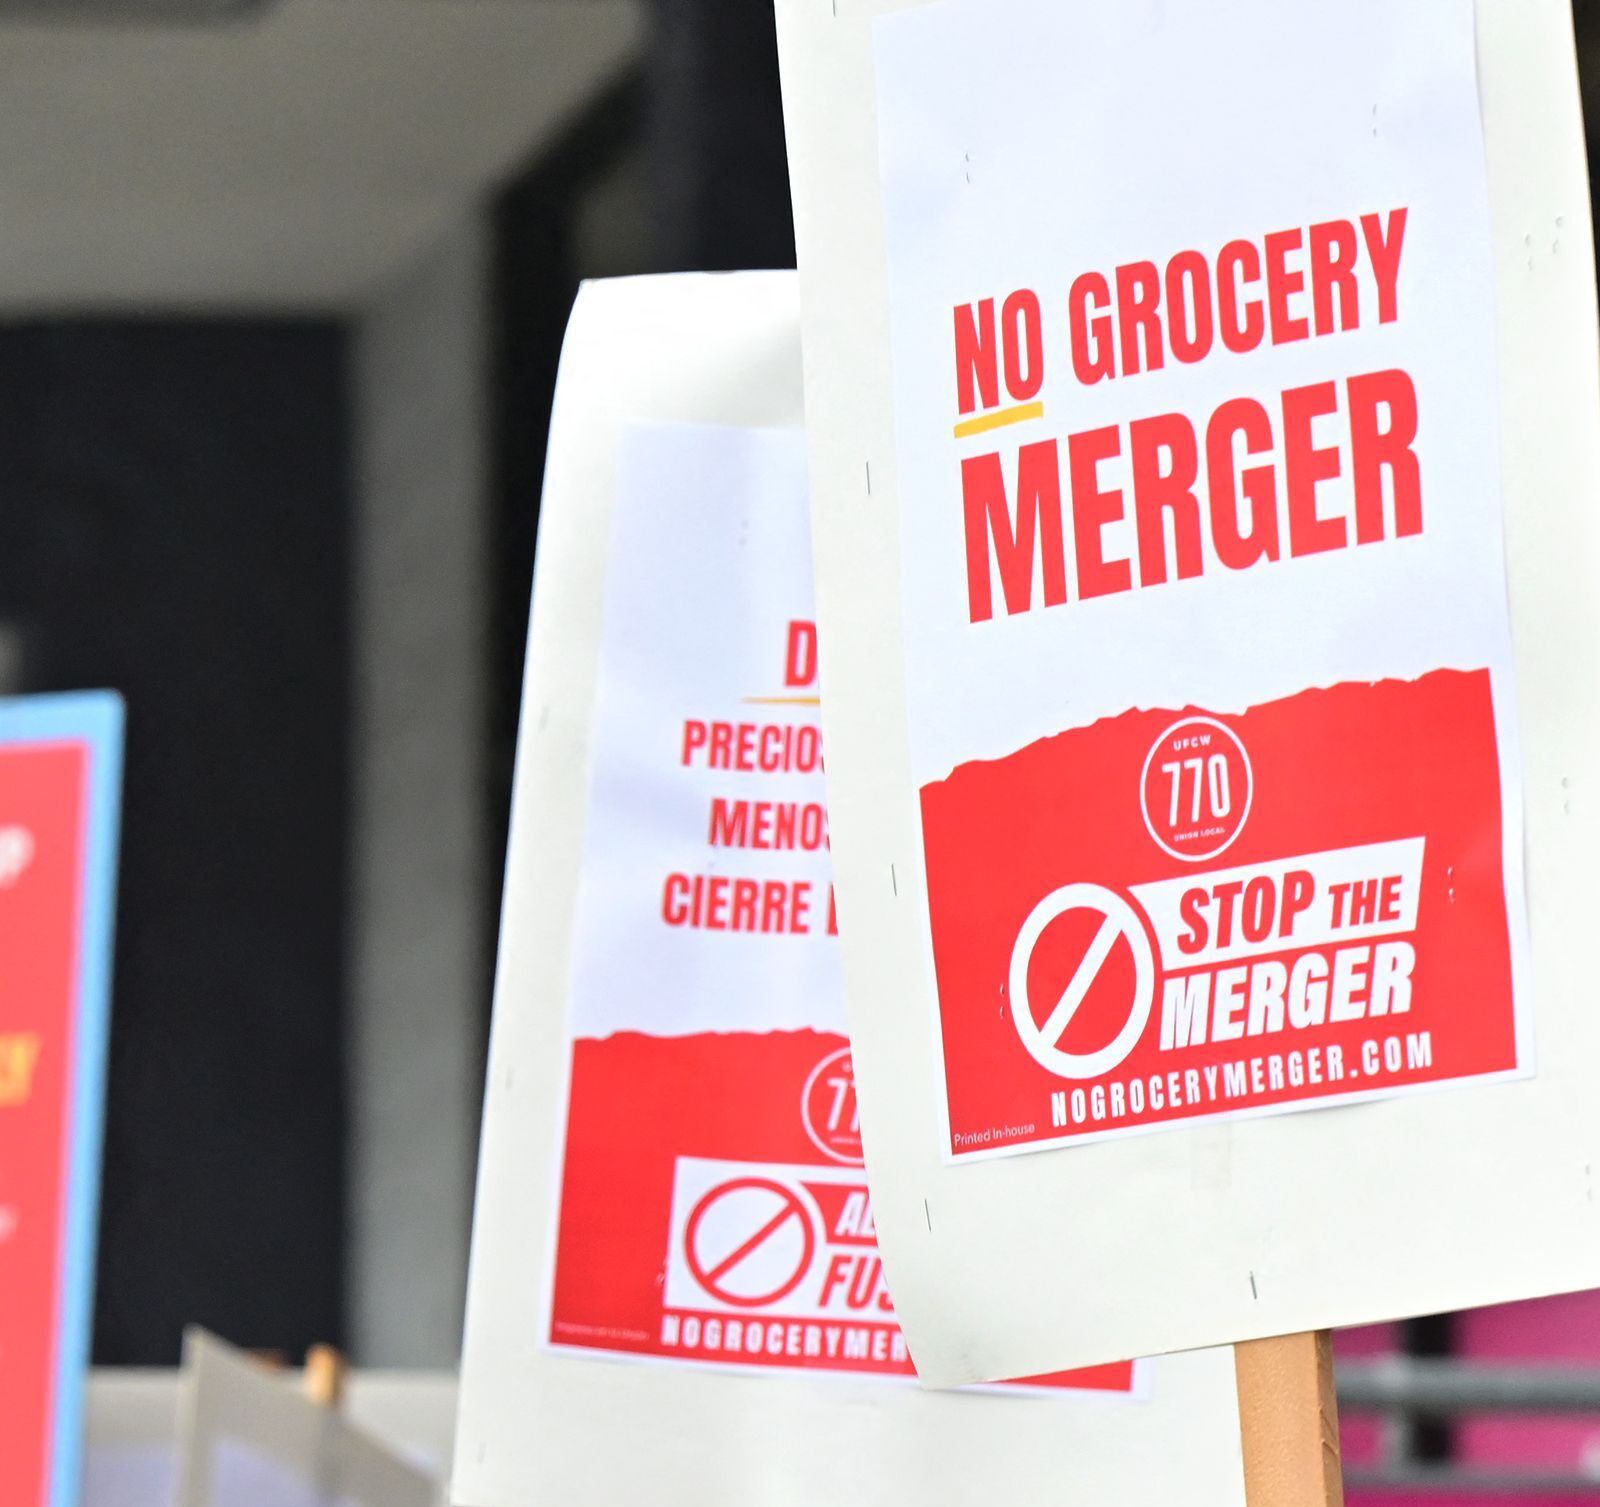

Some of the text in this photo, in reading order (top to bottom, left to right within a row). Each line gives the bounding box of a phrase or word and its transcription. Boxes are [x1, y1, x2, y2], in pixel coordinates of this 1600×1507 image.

[953, 206, 1409, 415] NO GROCERY
[960, 367, 1424, 625] MERGER
[681, 719, 825, 773] PRECIO
[1173, 734, 1211, 751] UFCW
[707, 797, 831, 853] MENO
[1161, 753, 1231, 828] 770
[1174, 826, 1226, 842] UNION LOCAL
[660, 871, 812, 936] CIERRE
[1176, 869, 1403, 956] STOP THE
[1158, 939, 1417, 1052] MERGER
[1050, 1030, 1434, 1128] NOGROCERYMERGER.COM
[953, 1124, 1036, 1147] Printed In-house
